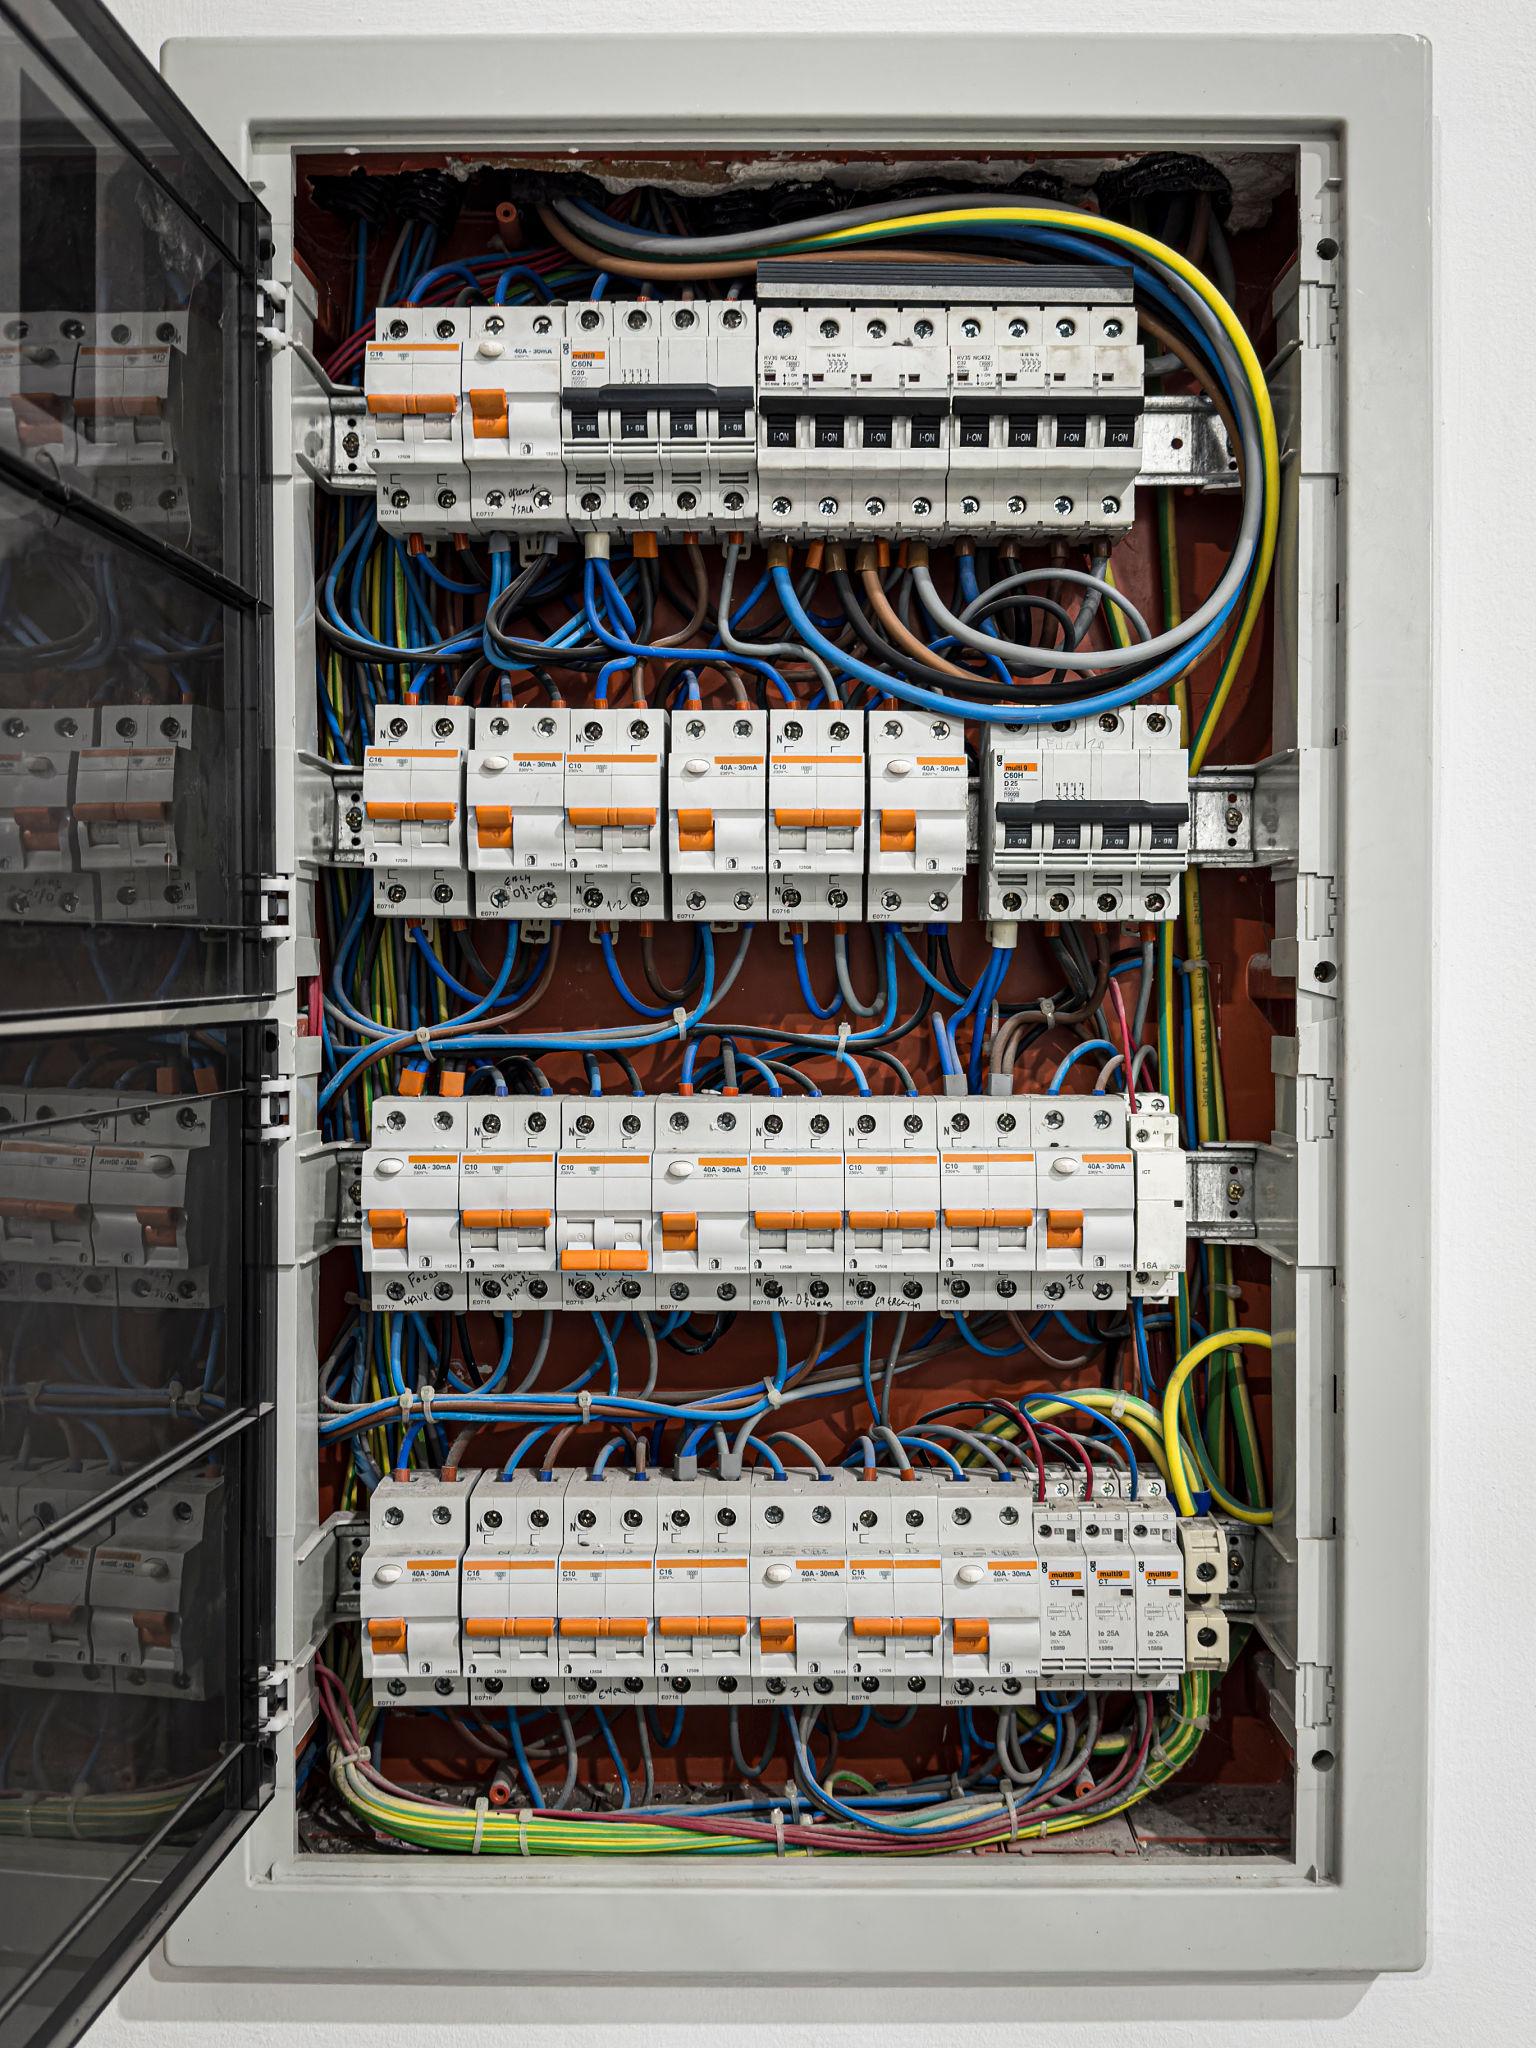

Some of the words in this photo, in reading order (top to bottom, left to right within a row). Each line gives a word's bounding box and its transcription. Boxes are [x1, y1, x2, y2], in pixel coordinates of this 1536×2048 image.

[382, 332, 389, 340] N
[571, 360, 593, 368] C60N
[383, 486, 389, 495] N
[380, 729, 386, 738] N
[575, 734, 582, 743] N
[776, 735, 783, 743] N
[379, 881, 386, 890] N
[576, 885, 582, 894] N
[775, 887, 781, 895] N
[474, 1127, 481, 1136] N
[569, 1127, 575, 1136] N
[756, 1128, 762, 1137] N
[848, 1127, 855, 1137] N
[943, 1127, 950, 1136] N
[1141, 1262, 1158, 1270] 16A
[474, 1278, 481, 1286] N
[568, 1278, 575, 1287] N
[755, 1278, 762, 1287] N
[848, 1278, 855, 1287] N
[943, 1277, 950, 1286] N
[477, 1523, 483, 1532] N
[570, 1523, 576, 1532] N
[662, 1522, 668, 1531] N
[852, 1523, 859, 1532] N
